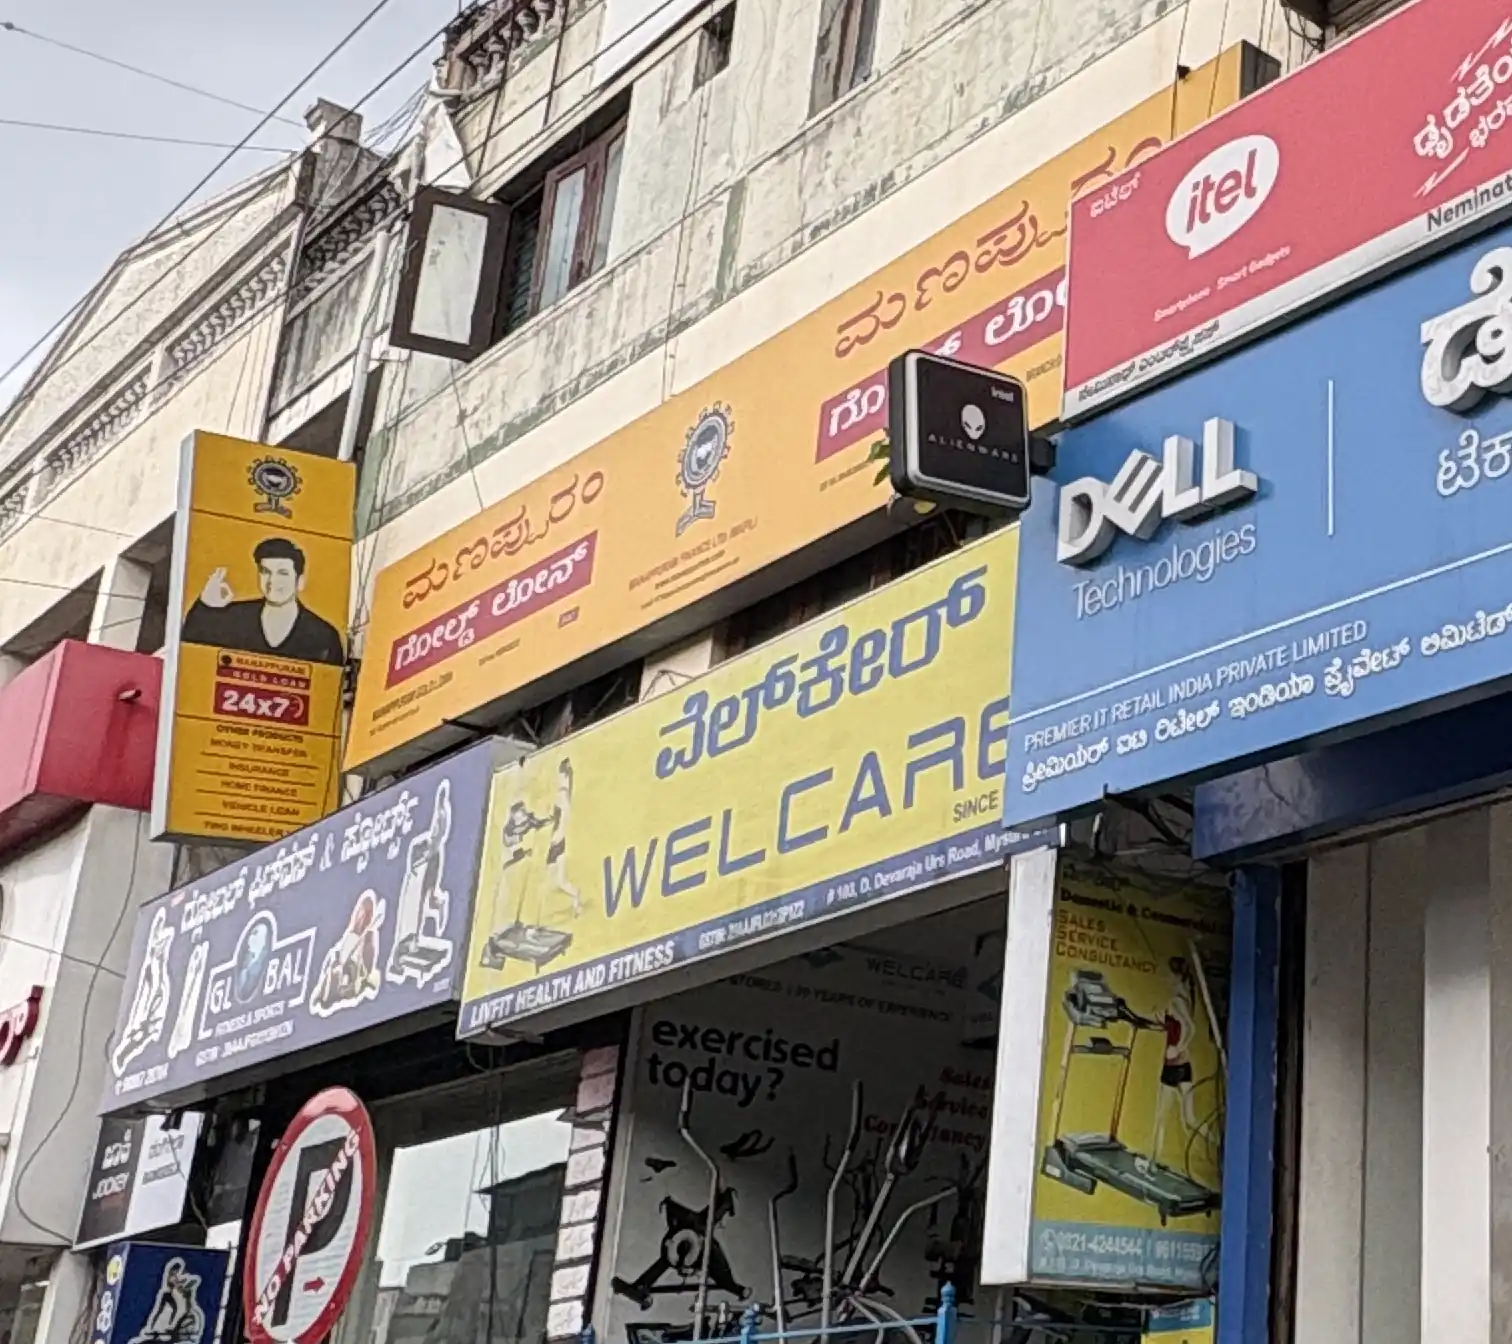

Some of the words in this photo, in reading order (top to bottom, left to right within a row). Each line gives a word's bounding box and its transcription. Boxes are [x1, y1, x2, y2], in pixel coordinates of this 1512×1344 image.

[1184, 147, 1260, 235] itel
[1056, 416, 1259, 567] DELL
[1072, 523, 1257, 621] Technologies
[221, 690, 290, 719] 24x7
[1023, 720, 1091, 753] PREMIER
[1092, 710, 1107, 731] IT
[1111, 691, 1166, 724] RETAIL
[1168, 673, 1214, 708] INDIA
[1215, 648, 1289, 688] PRIVATE
[1293, 618, 1368, 662] LIMITED
[602, 696, 1011, 920] WELCARE
[952, 789, 999, 824] SINCE
[924, 853, 945, 872] Urs
[1056, 925, 1119, 952] SERVICE
[1057, 908, 1106, 933] SALES
[514, 967, 574, 1015] HEALTH
[573, 958, 607, 1000] AND
[607, 939, 676, 988] FITNESS
[1055, 941, 1158, 975] CONSULTANCY
[651, 1019, 840, 1072] exercised
[646, 1051, 785, 1108] today?
[252, 1272, 282, 1325] NO
[283, 1127, 363, 1274] PARKING
